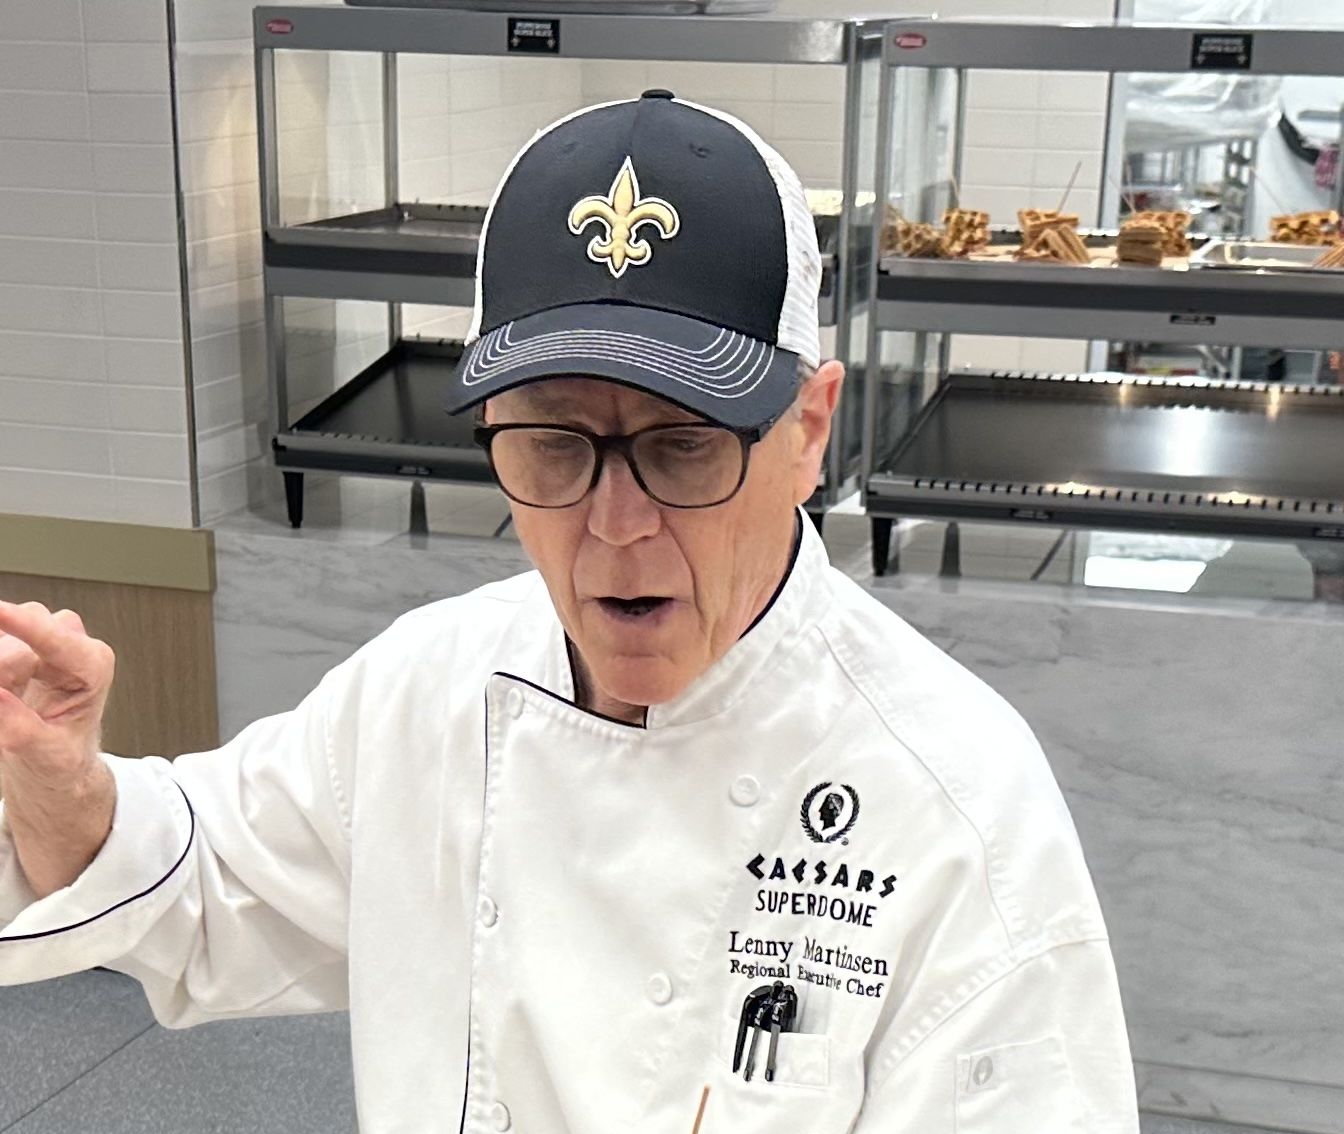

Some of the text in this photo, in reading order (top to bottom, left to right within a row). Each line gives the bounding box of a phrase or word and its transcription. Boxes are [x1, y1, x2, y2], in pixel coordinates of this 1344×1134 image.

[746, 853, 898, 898] CAESARS
[755, 889, 878, 928] SUPERDOME
[728, 931, 889, 976] Lenny Martinsen
[730, 959, 791, 980] Regional
[846, 977, 886, 998] Chef
